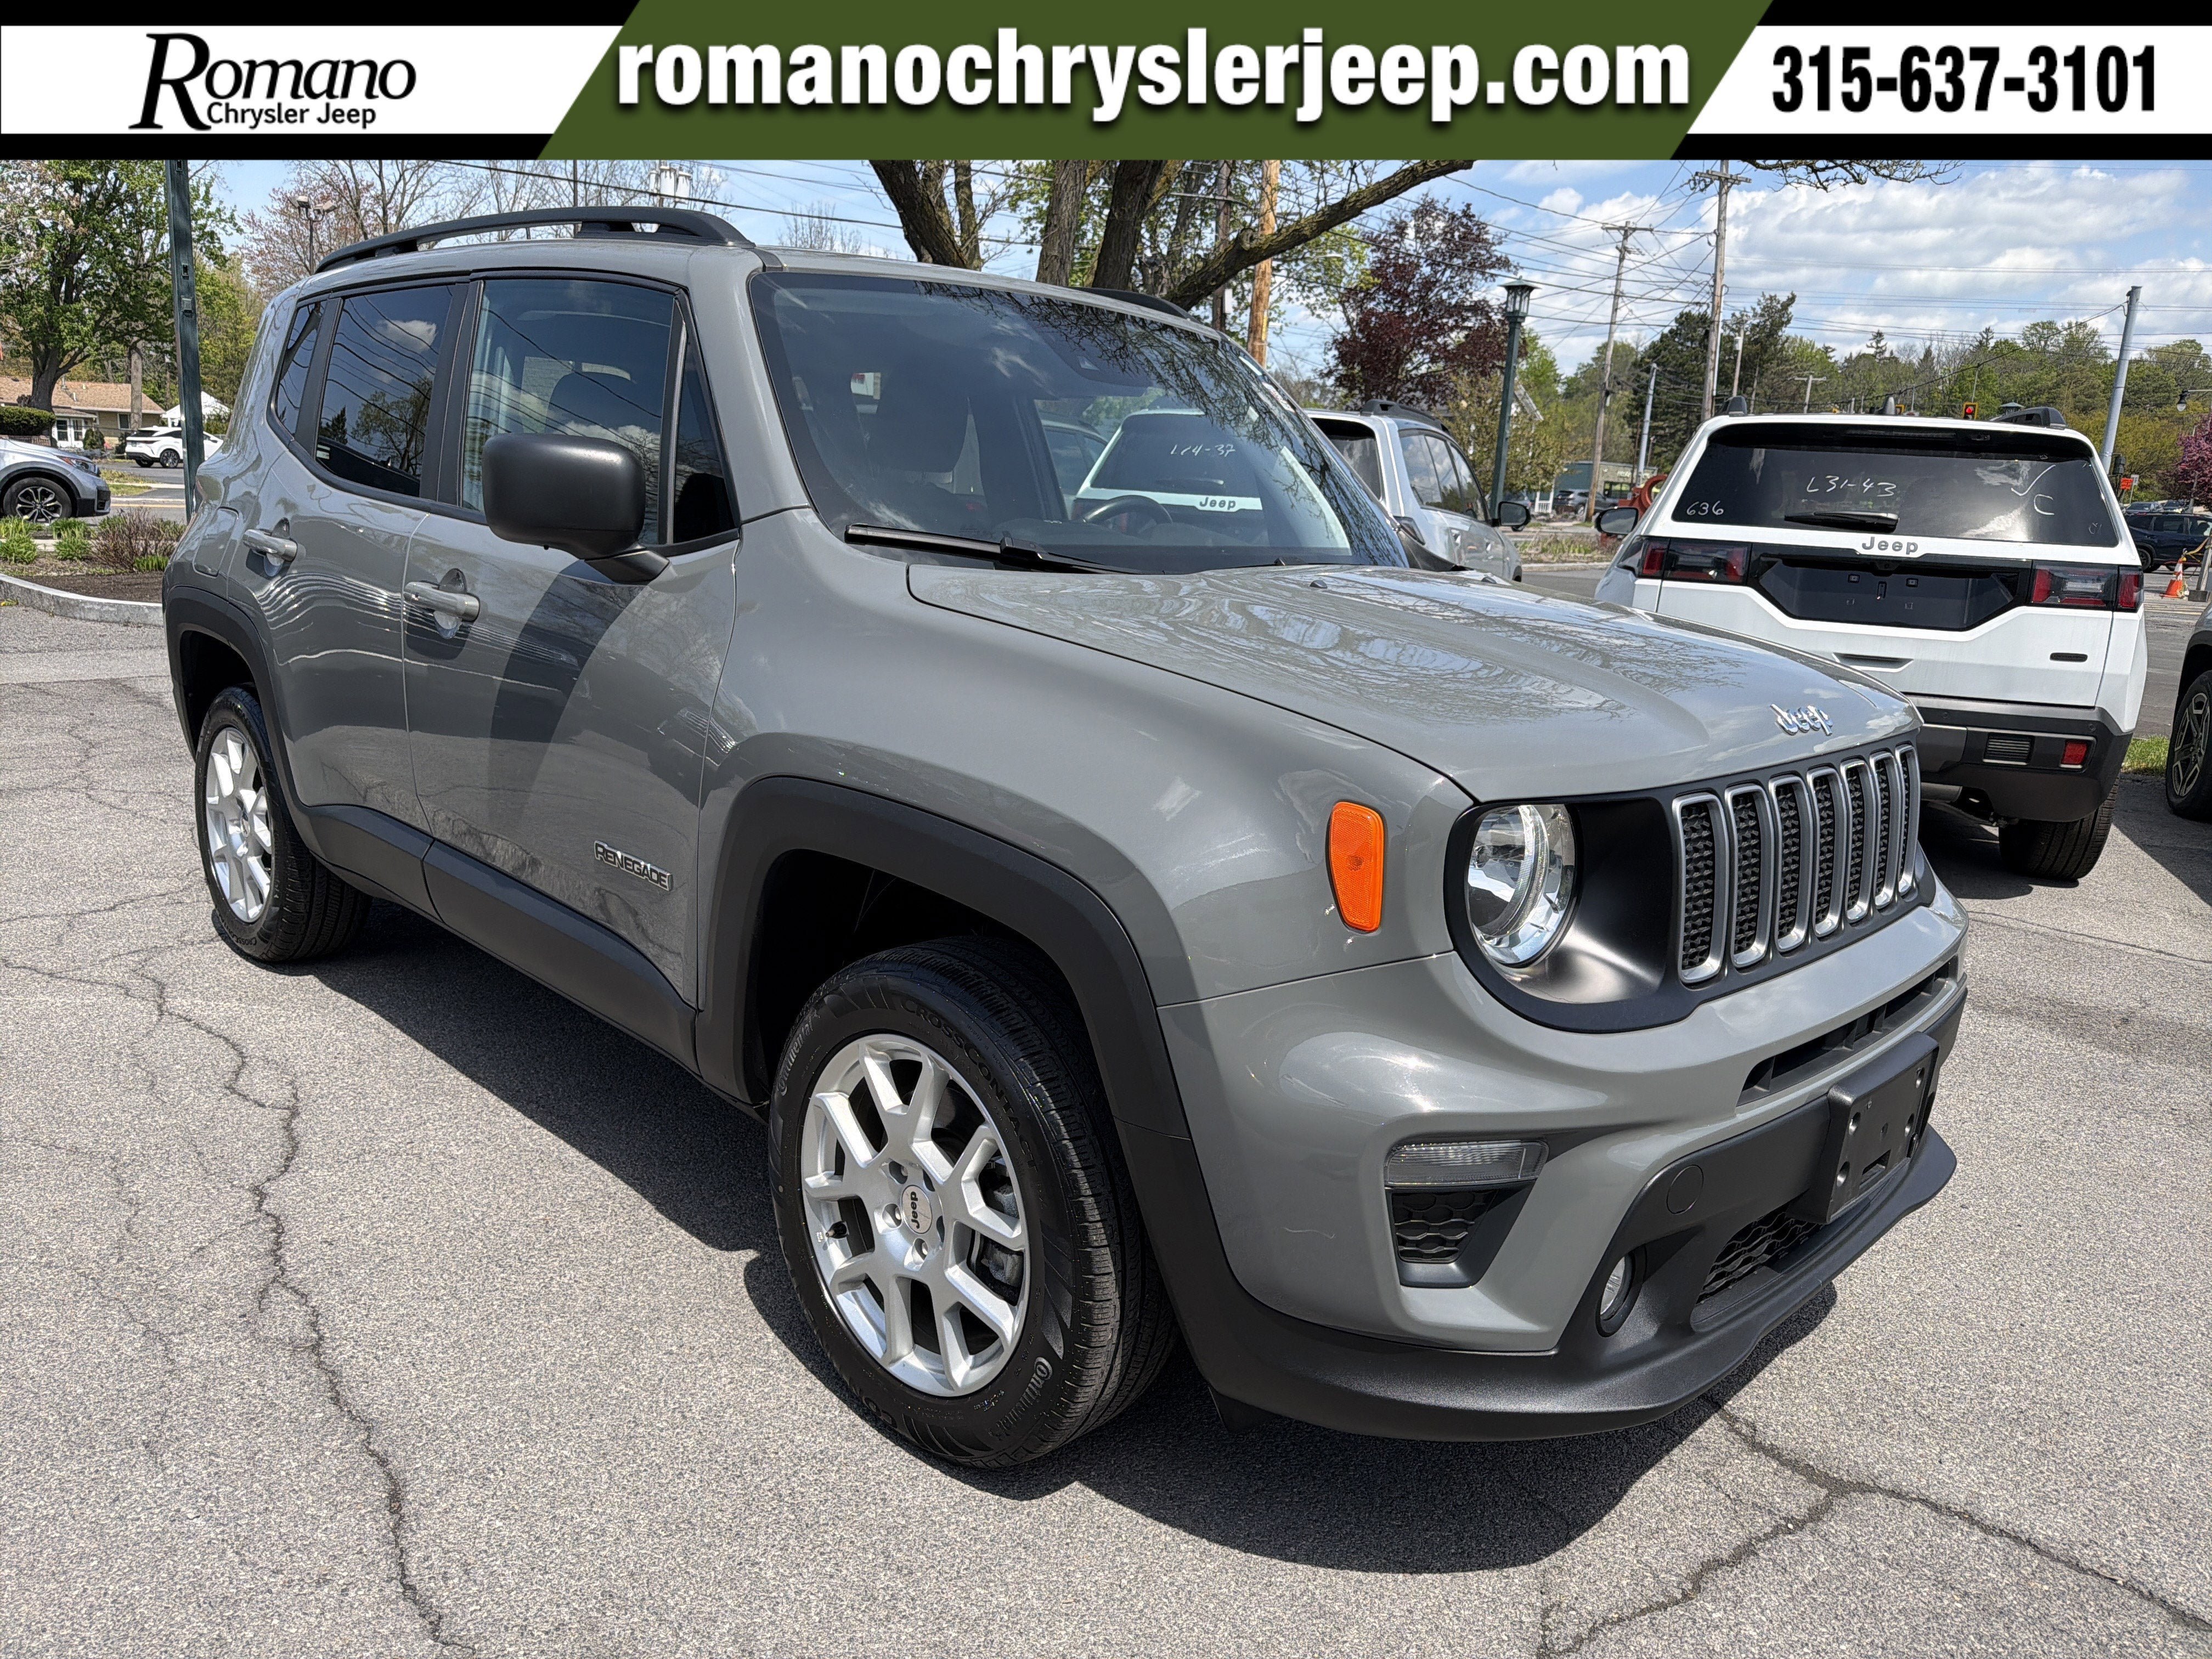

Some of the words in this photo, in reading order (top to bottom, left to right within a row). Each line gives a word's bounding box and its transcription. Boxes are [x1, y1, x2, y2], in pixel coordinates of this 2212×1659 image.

[1199, 496, 1236, 510] Jeep
[1686, 500, 1724, 516] 636
[1861, 536, 1919, 554] Jeep
[1770, 703, 1833, 736] Jeep
[594, 840, 673, 891] RENEGADE
[910, 1191, 920, 1229] Jeep
